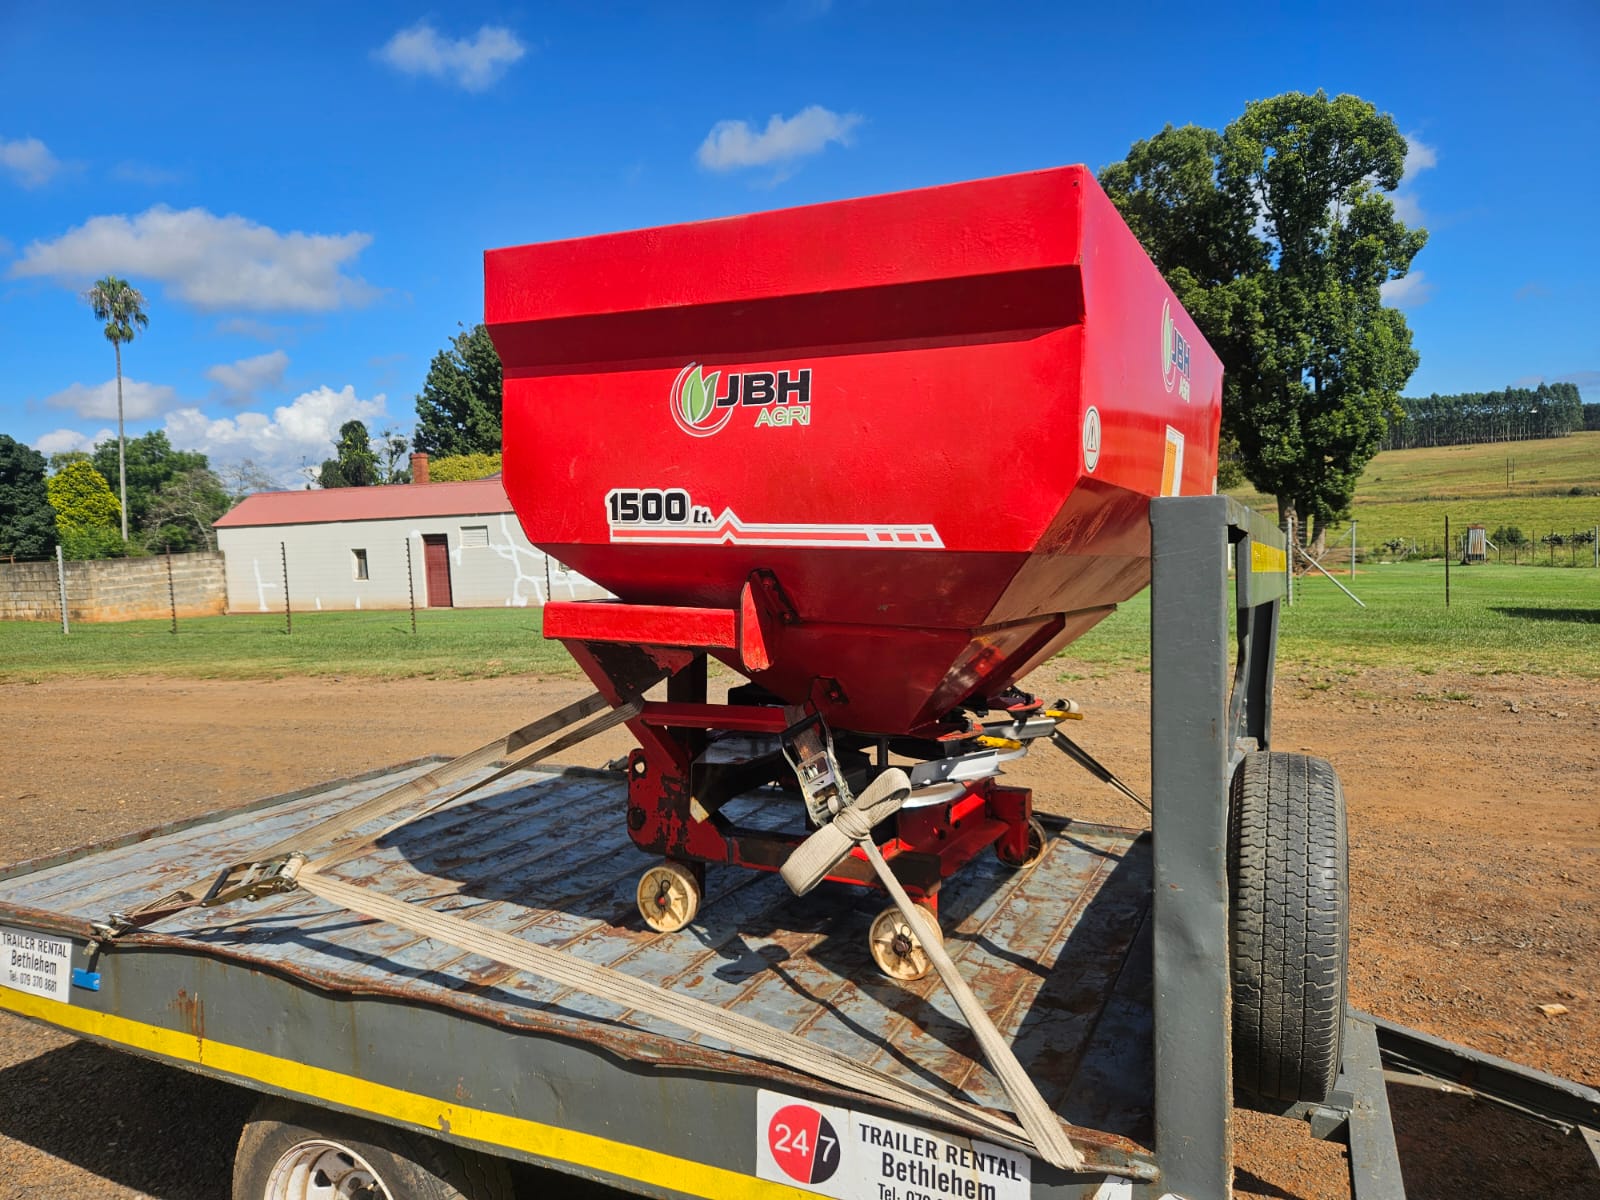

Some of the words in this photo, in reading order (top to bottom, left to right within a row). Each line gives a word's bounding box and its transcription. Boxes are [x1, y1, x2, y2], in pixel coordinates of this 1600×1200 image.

[1172, 328, 1190, 380] JBH
[716, 368, 812, 408] JBH
[754, 405, 811, 427] AGRI
[607, 491, 688, 522] 1500
[2, 933, 35, 951] TRAILER
[38, 939, 67, 958] RENTAL
[11, 949, 57, 976] Bethlehem
[774, 1122, 809, 1157] 24
[818, 1135, 836, 1163] 7
[859, 1123, 937, 1159] TRAILER
[946, 1140, 1022, 1181] RENTAL
[882, 1151, 996, 1200] Bethlehem
